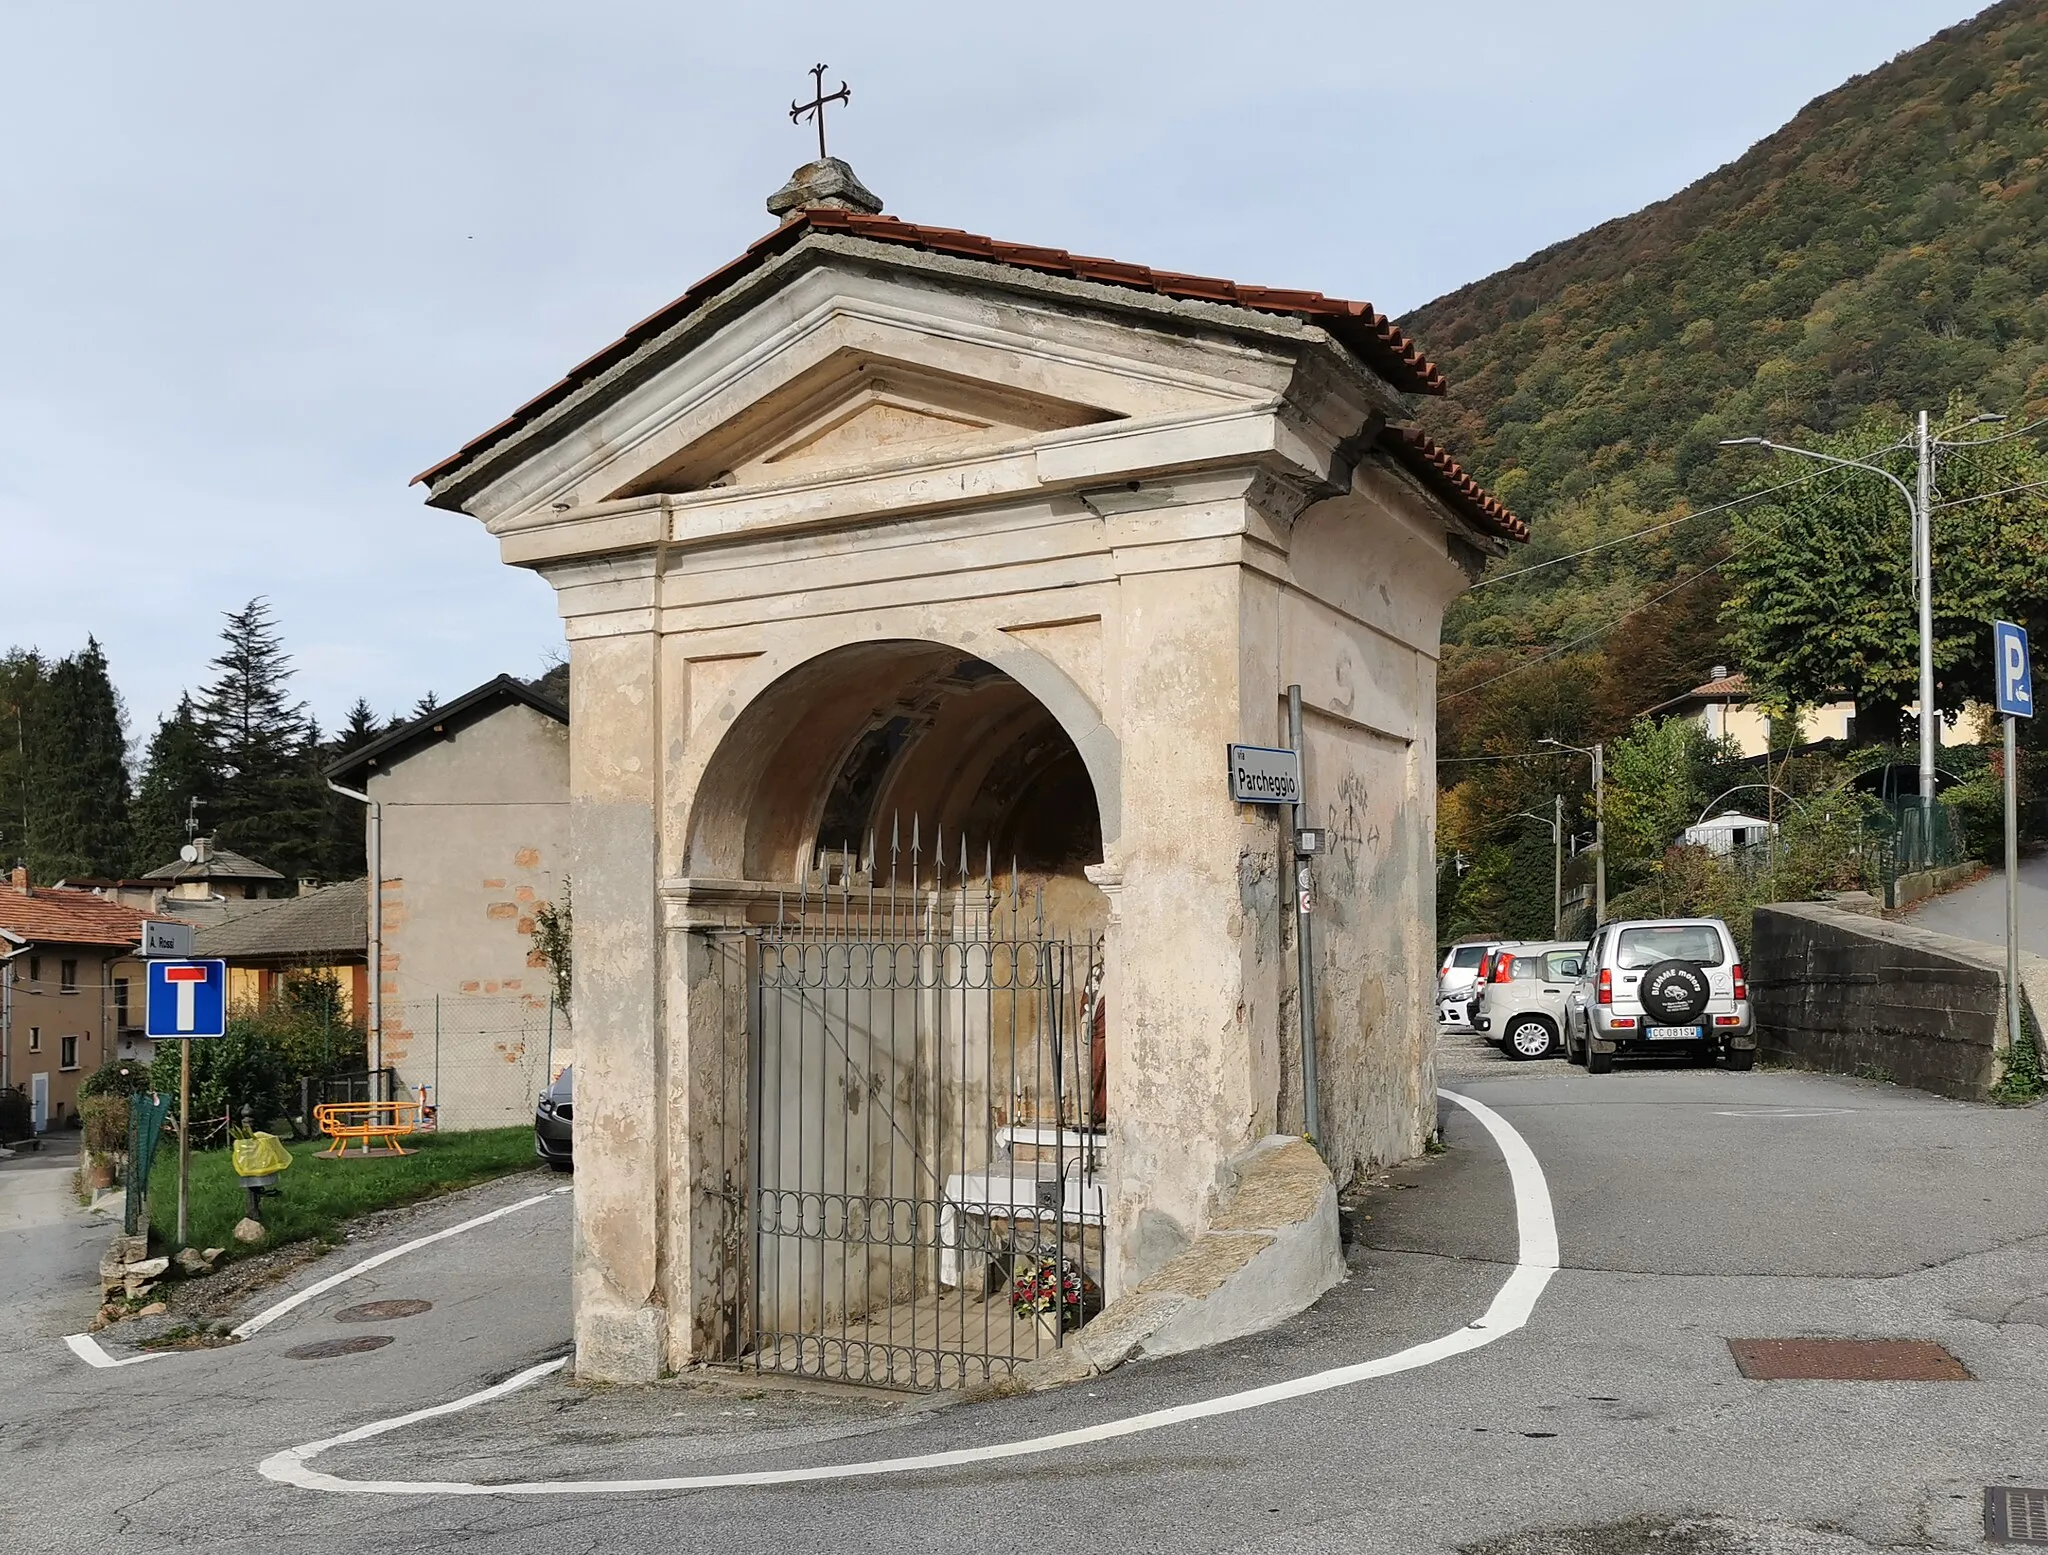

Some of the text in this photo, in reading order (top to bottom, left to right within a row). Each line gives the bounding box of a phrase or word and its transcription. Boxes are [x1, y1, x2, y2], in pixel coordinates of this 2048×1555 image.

[2004, 634, 2024, 702] P
[1238, 767, 1295, 797] Parcheggio
[159, 936, 175, 949] Rossi
[1678, 970, 1702, 992] motors
